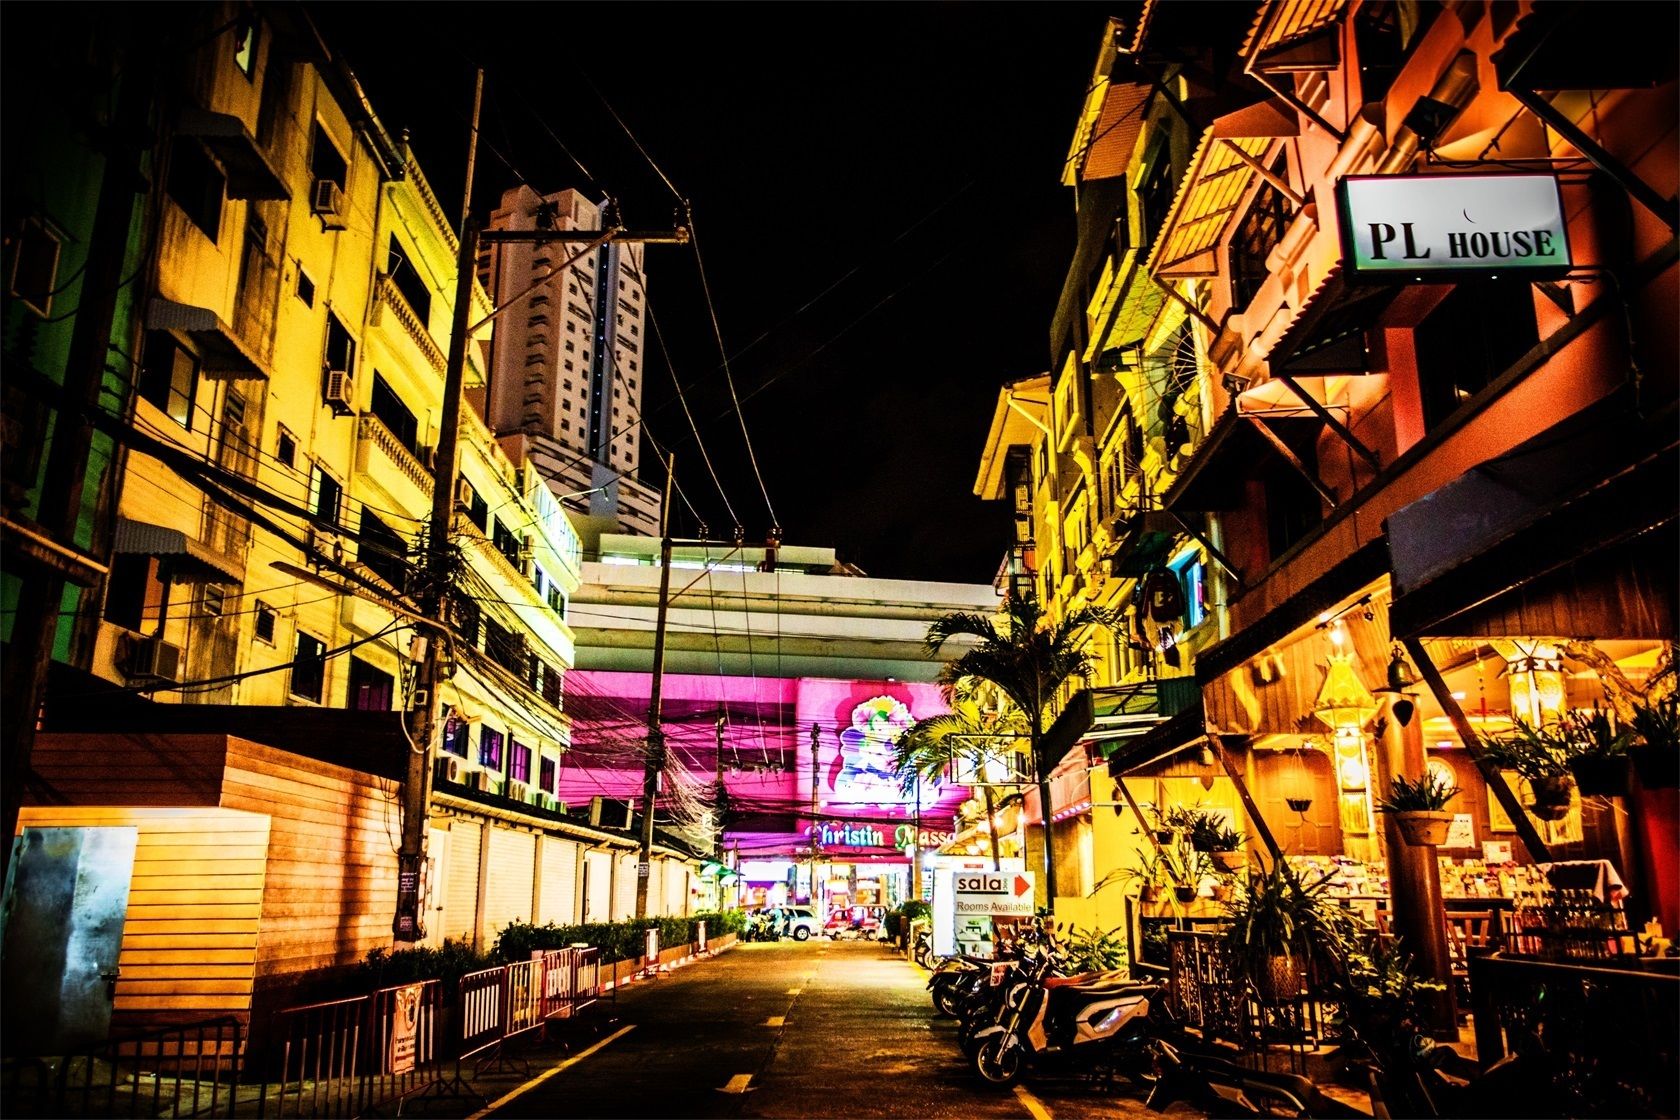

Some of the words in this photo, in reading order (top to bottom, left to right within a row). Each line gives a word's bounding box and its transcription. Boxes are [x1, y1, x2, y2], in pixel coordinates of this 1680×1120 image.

[1368, 222, 1431, 260] PL
[1448, 230, 1556, 259] HOUSE
[958, 874, 1001, 890] sala
[957, 901, 989, 912] Rooms
[991, 902, 1031, 912] Available
